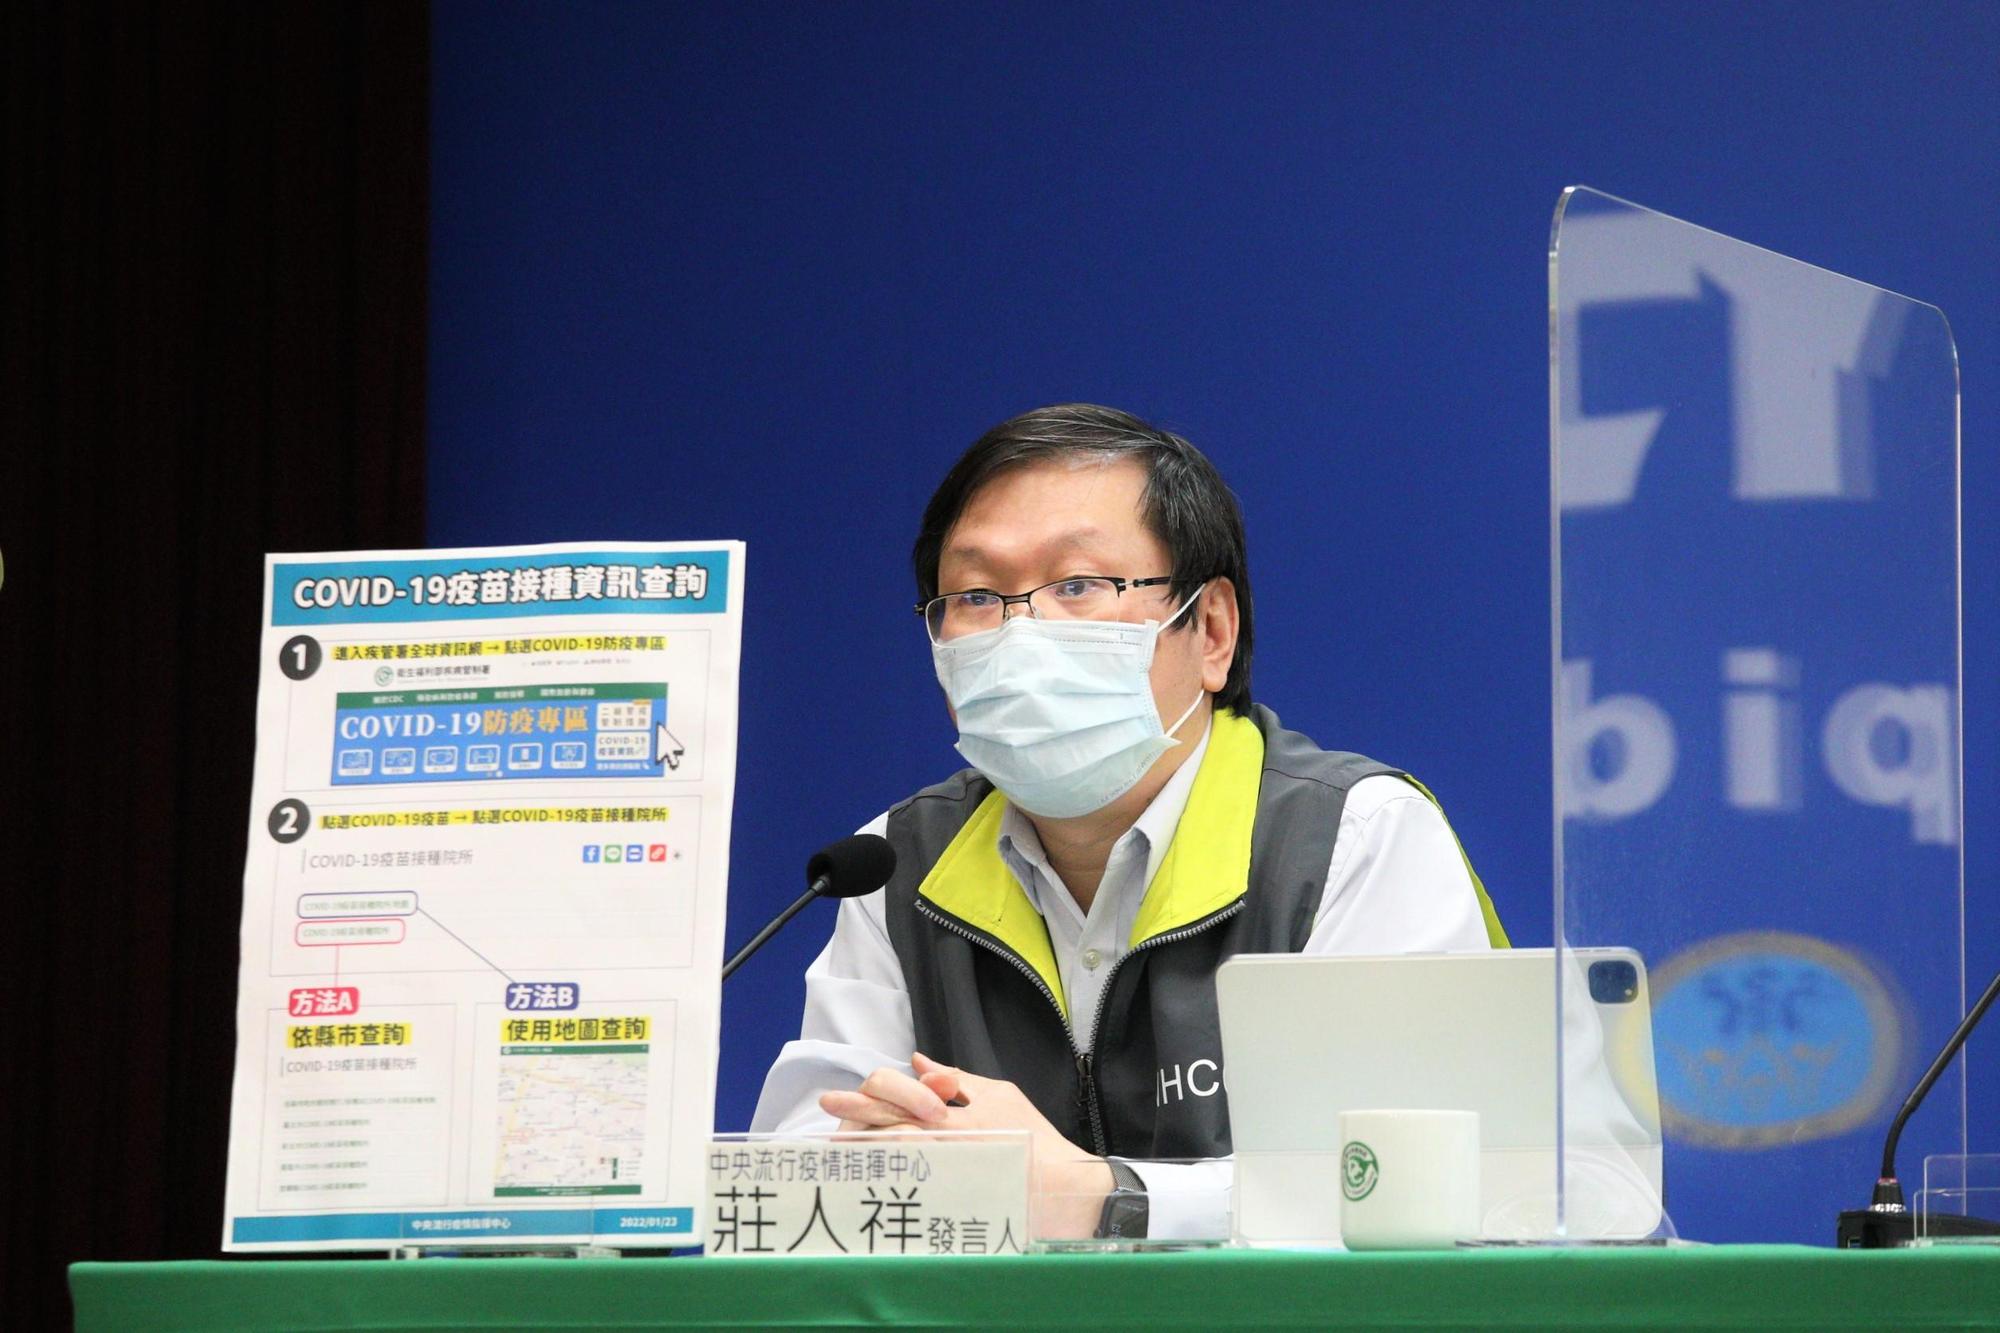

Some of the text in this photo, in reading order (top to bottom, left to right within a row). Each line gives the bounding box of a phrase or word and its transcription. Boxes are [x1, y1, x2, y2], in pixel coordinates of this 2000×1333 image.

[294, 564, 708, 609] COVID-19疫苗接種資訊查詢
[291, 643, 307, 671] 1
[335, 636, 665, 660] 進入疾管署全球資訊網 點選COVID-19防疫專區
[340, 705, 588, 740] COVID-19防疫專區
[278, 806, 298, 835] 2
[321, 807, 667, 829] 點選COVID-19疫苗 點選COVID-19疫苗接種院所
[310, 849, 473, 868] COVID-19疫苗接種院所
[292, 990, 353, 1015] 方法A
[508, 985, 574, 1010] 方法B
[292, 1022, 405, 1048] 依縣市查詢
[507, 1017, 646, 1042] 使用地圖查詢
[710, 1148, 931, 1182] 中央流行疫情指揮中心
[620, 1217, 678, 1228] 2022/01/23
[713, 1186, 1021, 1254] 莊人祥 發言人
